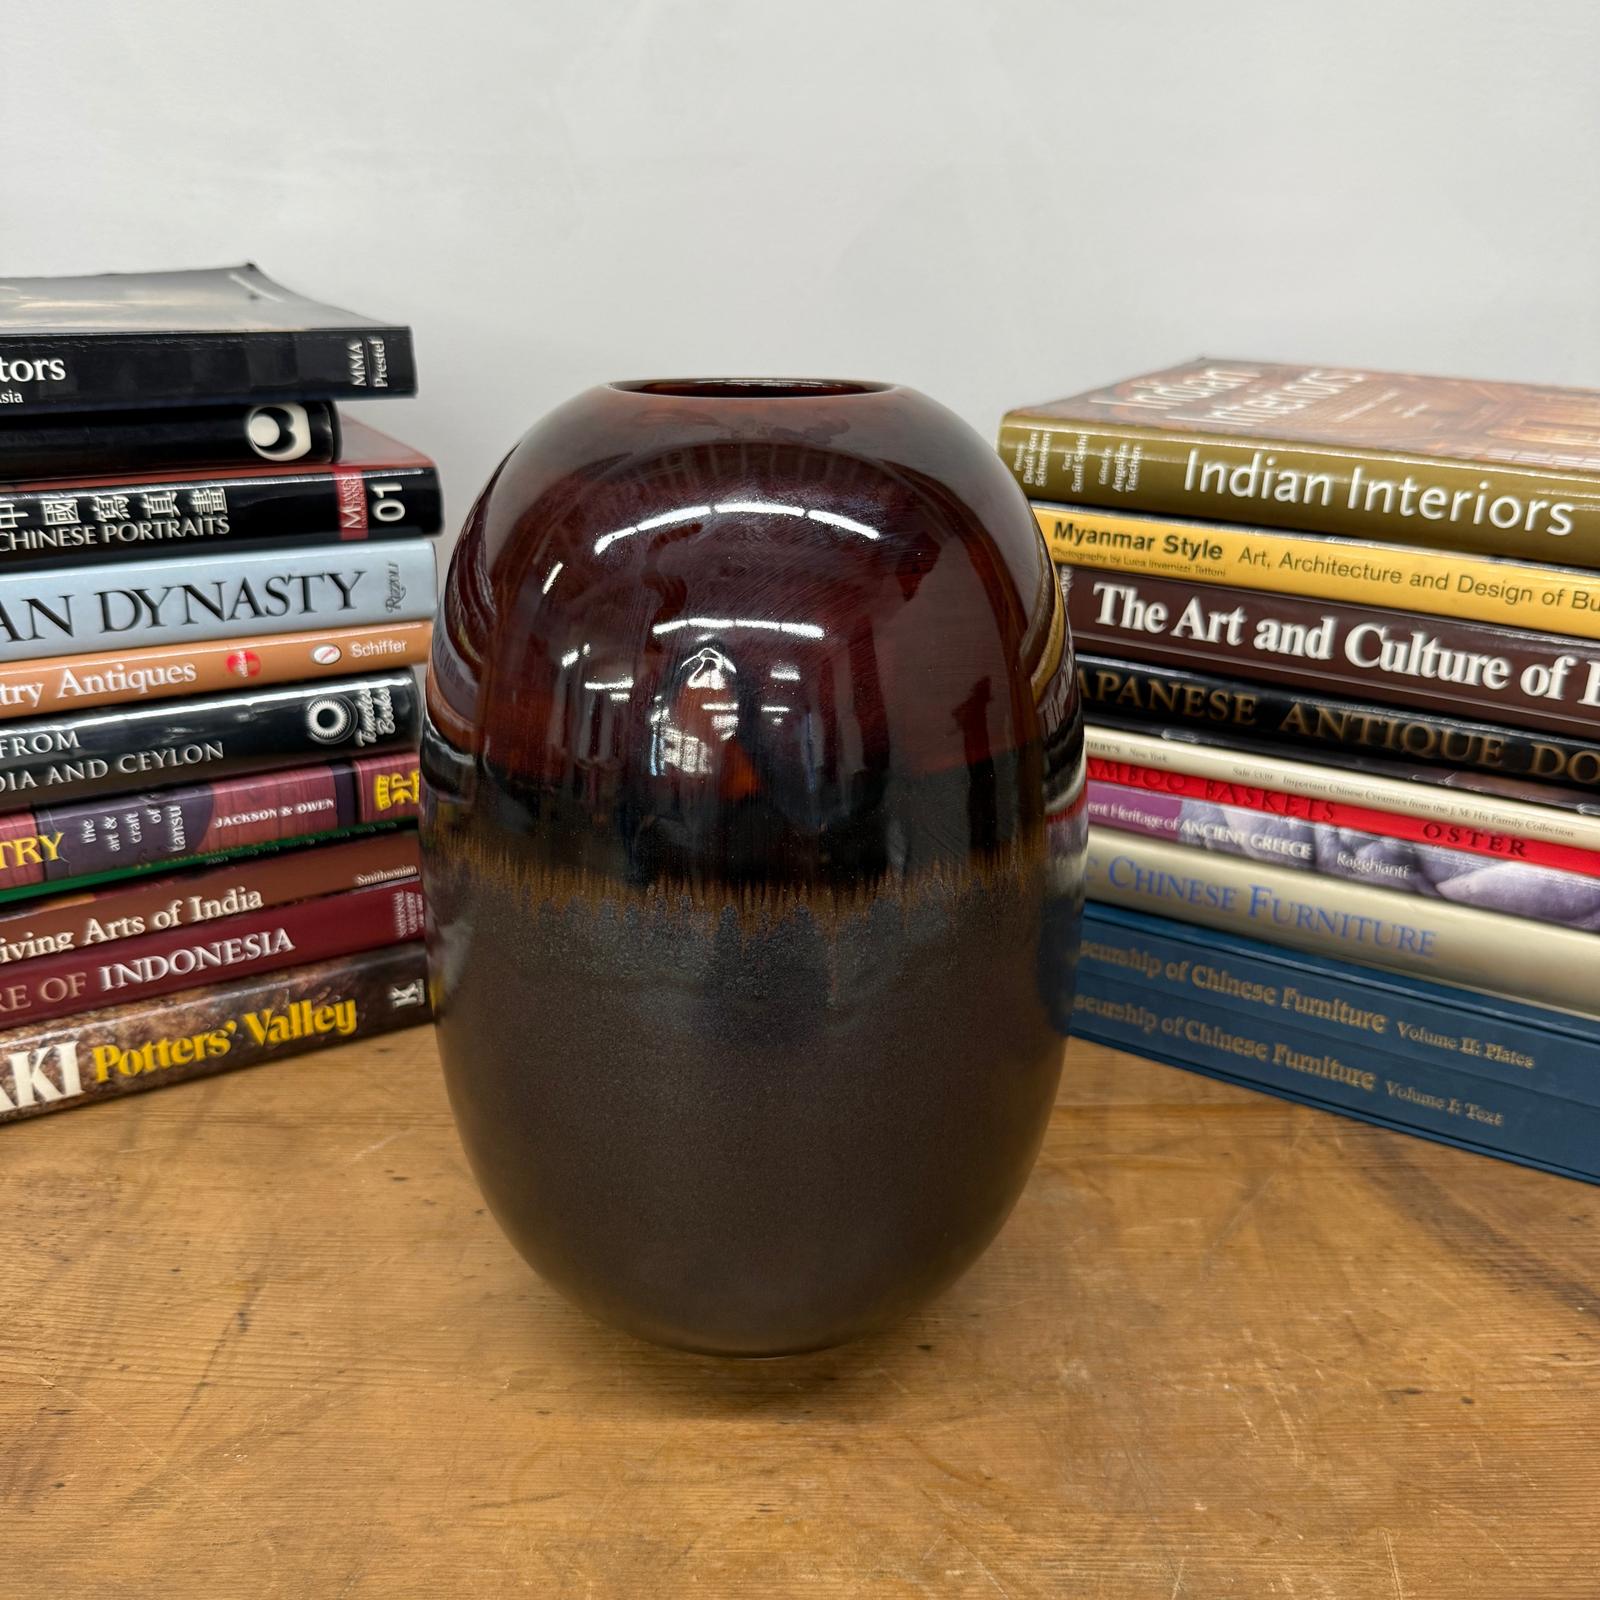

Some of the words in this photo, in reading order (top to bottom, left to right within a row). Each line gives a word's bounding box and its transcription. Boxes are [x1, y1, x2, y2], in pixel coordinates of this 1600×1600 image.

[0, 356, 66, 382] tors
[348, 341, 367, 386] MMA
[368, 337, 388, 387] Prestel
[0, 391, 24, 404] sia
[1088, 368, 1262, 410] Indian
[1071, 465, 1083, 493] Sunil
[1125, 446, 1143, 493] Taschen
[1184, 447, 1331, 506] Indian
[1347, 464, 1574, 536] Interiors
[370, 483, 405, 522] 01
[0, 525, 98, 551] CHINESE
[101, 515, 230, 544] PORTRAITS
[1054, 521, 1156, 552] Myanmar
[1163, 534, 1223, 561] Style
[1238, 547, 1271, 569] Art,
[1279, 551, 1402, 584] Architecture
[1409, 572, 1450, 591] and
[1458, 575, 1532, 605] Design
[1541, 588, 1566, 606] of
[1109, 552, 1121, 563] by
[94, 570, 367, 632] DYNASTY
[351, 639, 407, 658] Schiffer
[1093, 581, 1169, 634] The
[1170, 595, 1247, 647] Art
[1253, 614, 1338, 660] and
[1344, 621, 1512, 690] Culture
[1520, 654, 1578, 700] of
[0, 681, 44, 708] try
[56, 663, 196, 698] Antiques
[354, 688, 377, 747] Timeles
[372, 688, 396, 736] Books
[47, 758, 109, 785] AND
[113, 741, 224, 774] CEYLON
[1279, 701, 1506, 768] ANTIQUE
[1529, 742, 1600, 784] DO
[215, 807, 278, 828] JACKSON
[281, 805, 293, 817] &
[297, 798, 334, 814] OWEN
[1130, 748, 1147, 759] New
[1150, 751, 1168, 762] York
[1283, 775, 1327, 791] Important
[1328, 784, 1363, 799] Chinese
[1365, 789, 1407, 807] Ceramics
[1409, 799, 1430, 811] from
[1433, 803, 1448, 814] the
[1491, 814, 1523, 829] Family
[1525, 821, 1574, 838] Collection
[1205, 779, 1334, 819] BASKETS
[81, 818, 97, 844] the
[103, 816, 118, 830] &
[126, 811, 142, 844] craft
[145, 808, 162, 824] of
[168, 804, 186, 853] tansu
[0, 832, 64, 870] TRY
[106, 832, 120, 852] art
[1111, 803, 1164, 830] Heritage
[1163, 817, 1180, 830] of
[1181, 818, 1246, 845] ANCIENT
[1250, 833, 1312, 860] GREECE
[1337, 852, 1410, 878] Ragghianti
[1423, 823, 1526, 857] OSTER
[355, 864, 417, 885] Smithsonian
[0, 931, 75, 964] iving
[82, 916, 146, 945] Arts
[153, 900, 183, 930] of
[188, 886, 264, 922] India
[1108, 855, 1238, 911] CHINESE
[1248, 883, 1438, 956] FURNITURE
[40, 972, 87, 1002] OF
[98, 928, 296, 992] INDONESIA
[1165, 960, 1191, 982] of
[1192, 965, 1277, 1005] Chinese
[1281, 987, 1389, 1034] Furniture
[1396, 1021, 1457, 1050] Volume
[1484, 1042, 1535, 1069] Plates
[92, 1019, 237, 1082] Potters'
[243, 999, 357, 1046] Valley
[1161, 1016, 1185, 1036] of
[1184, 1020, 1269, 1062] Chinese
[1272, 1042, 1376, 1093] Furniture
[1386, 1080, 1444, 1110] Volume
[1465, 1102, 1504, 1127] Text
